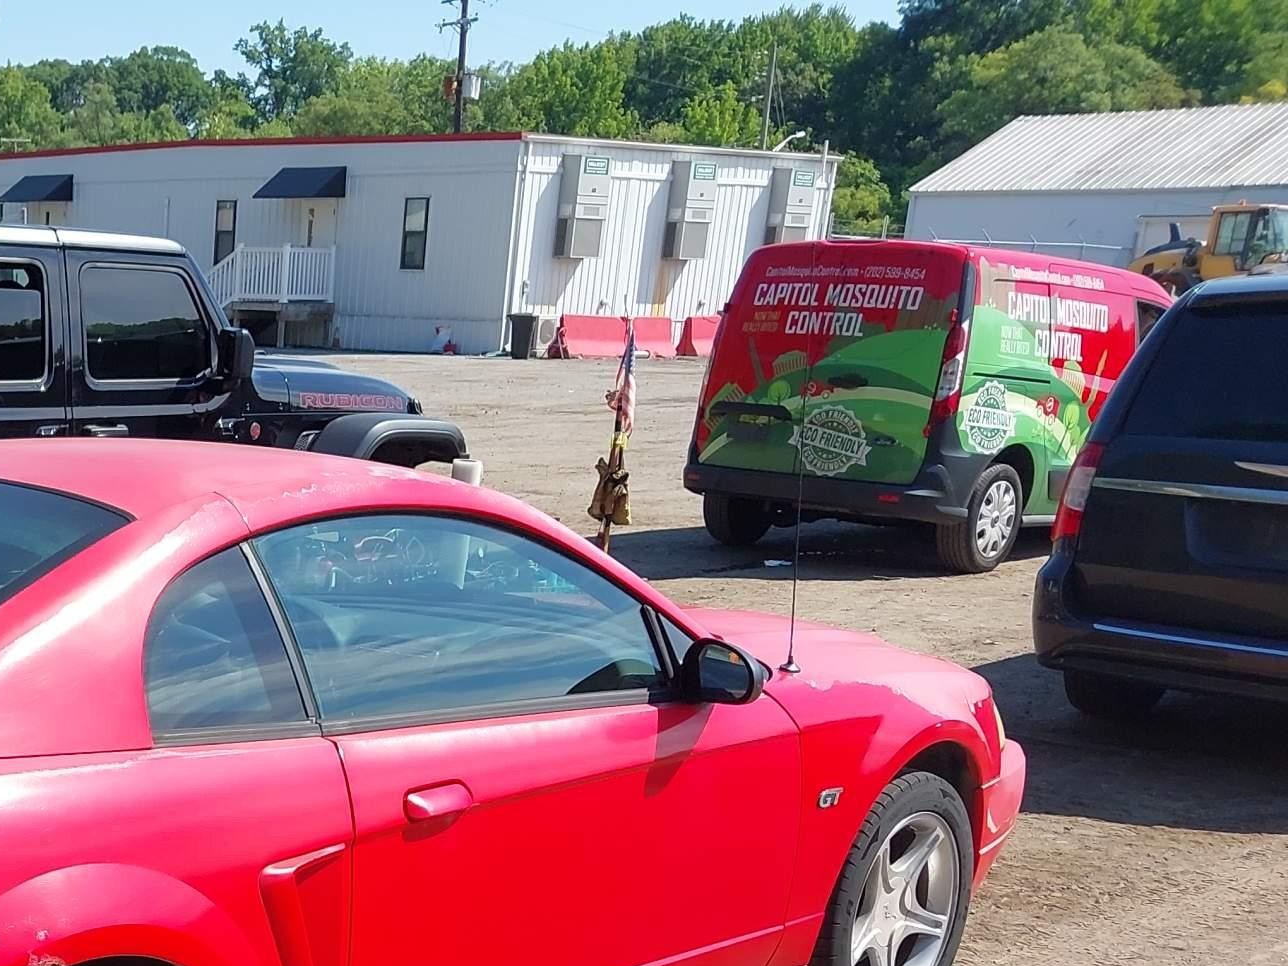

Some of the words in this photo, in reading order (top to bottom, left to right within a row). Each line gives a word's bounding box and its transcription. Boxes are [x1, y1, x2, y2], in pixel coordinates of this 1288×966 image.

[754, 283, 819, 306] CAPITOL
[785, 311, 863, 337] CONTROL
[1008, 291, 1055, 324] CAPITOL
[1056, 297, 1109, 333] MOSQUITO
[1034, 329, 1082, 362] CONTROL
[299, 392, 404, 410] RUBICON
[968, 408, 982, 424] ECO
[982, 410, 1012, 428] FRIENDLY
[819, 430, 865, 455] FRIENDLY
[818, 787, 844, 808] GT
